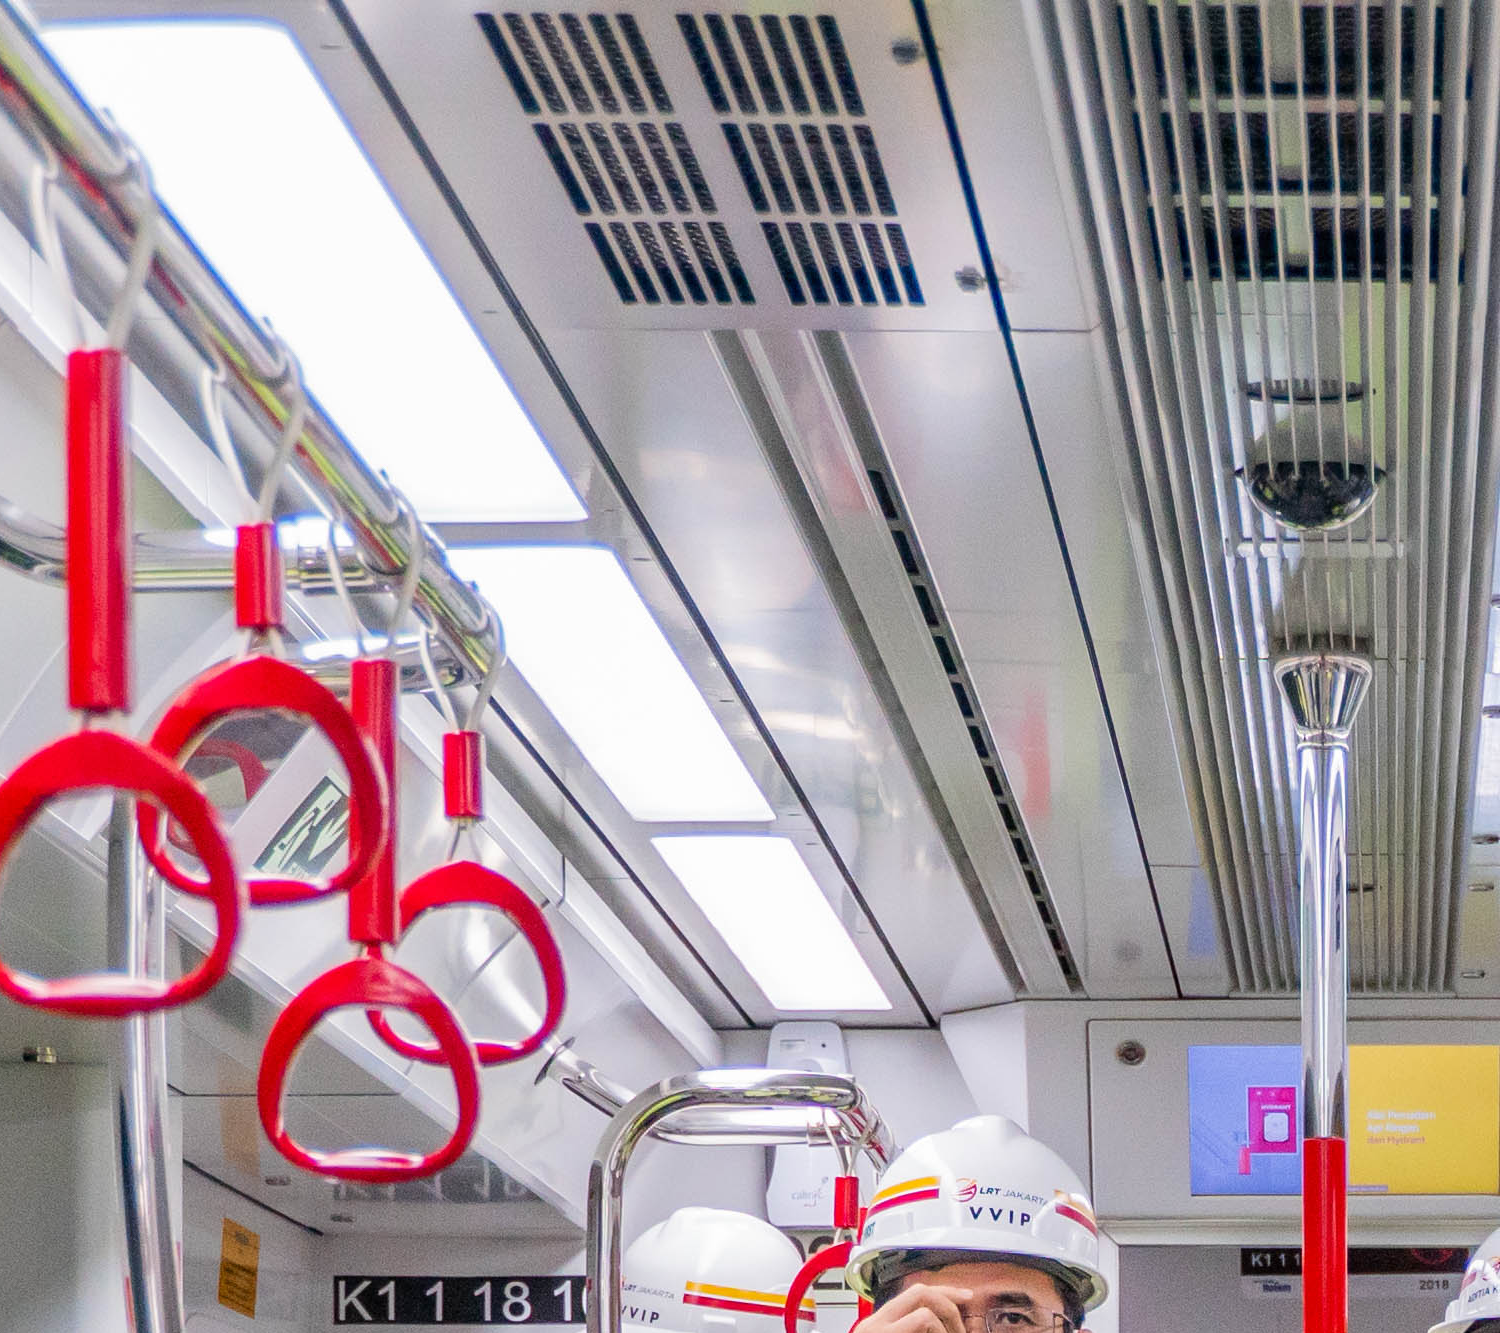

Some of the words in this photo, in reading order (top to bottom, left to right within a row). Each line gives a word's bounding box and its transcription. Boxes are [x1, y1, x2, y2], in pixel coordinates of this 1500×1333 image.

[979, 1186, 1001, 1197] LRT
[969, 1206, 1031, 1227] VVIP
[1419, 1279, 1450, 1291] 2018
[338, 1280, 396, 1322] K1
[473, 1280, 532, 1322] 18
[553, 1280, 587, 1322] 1
